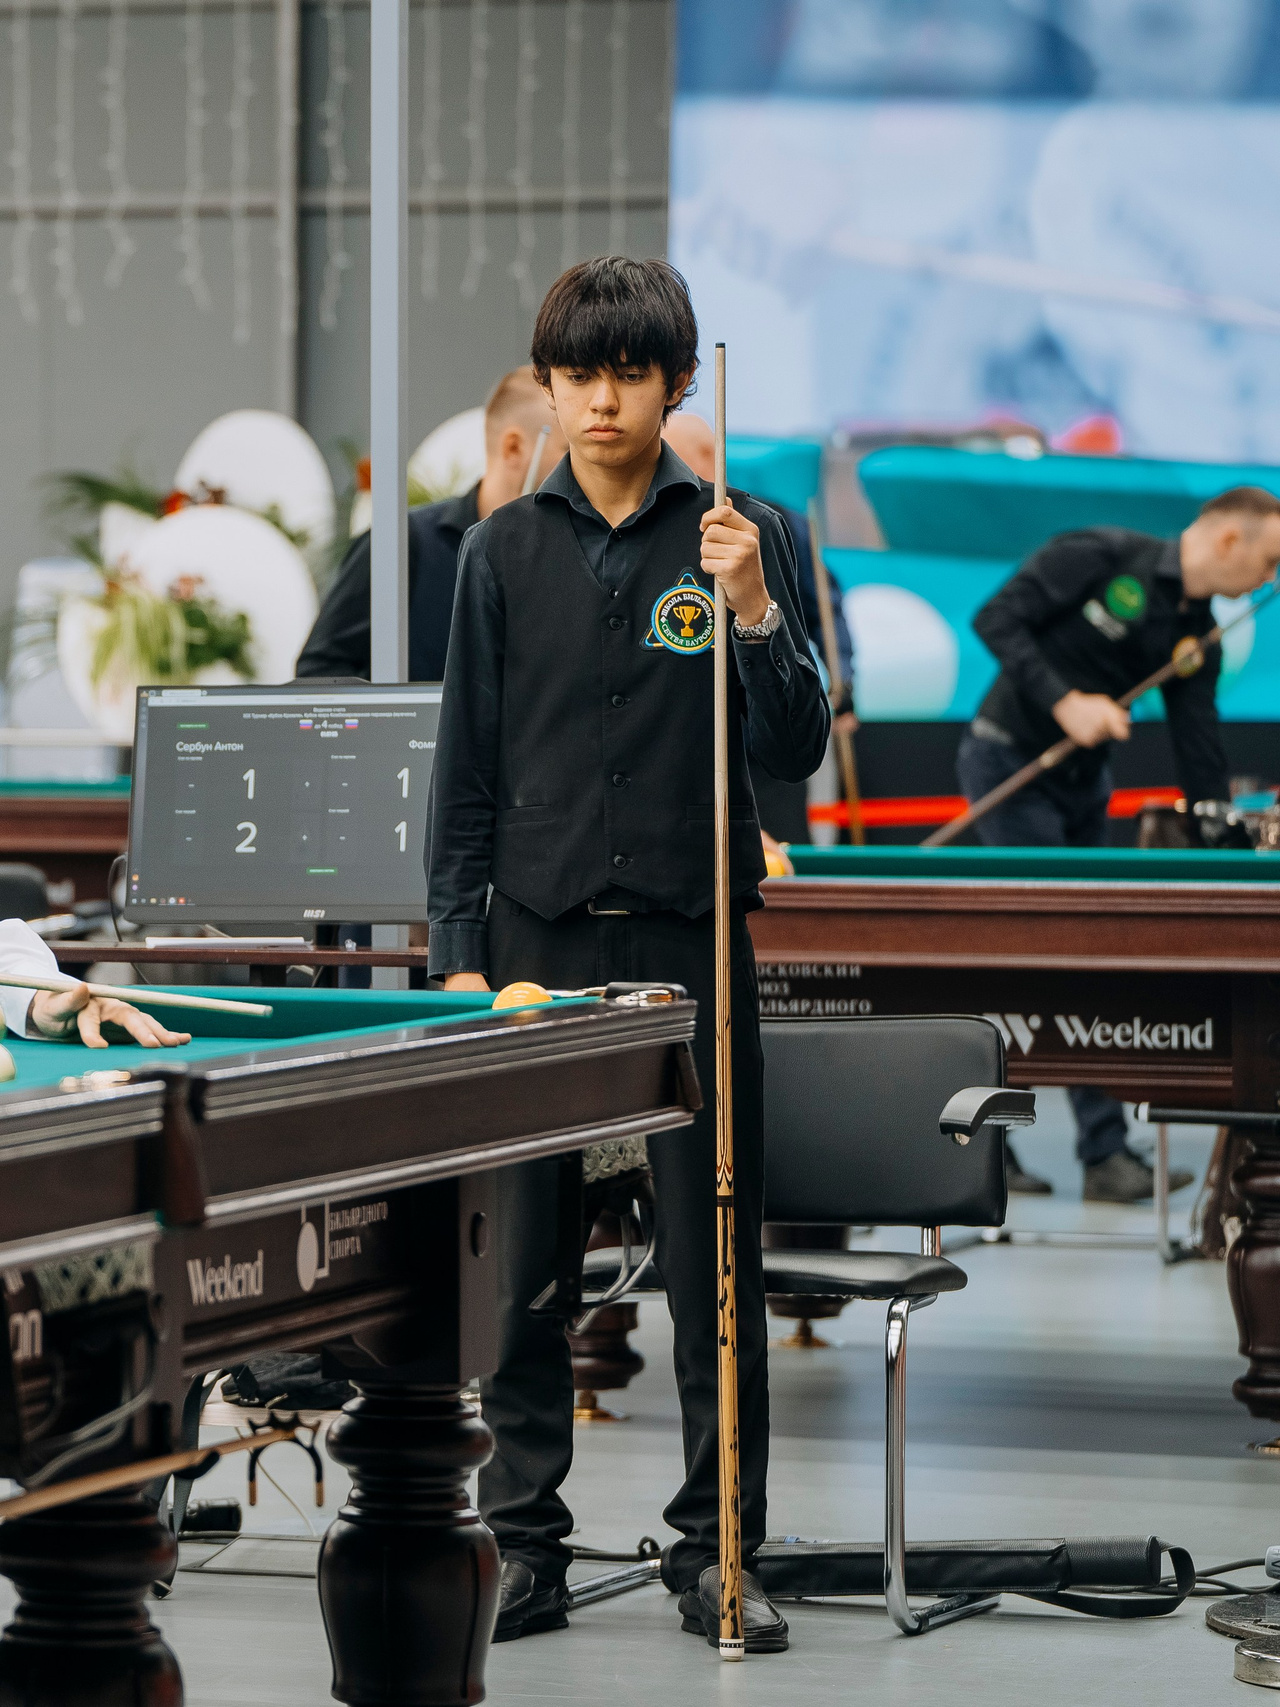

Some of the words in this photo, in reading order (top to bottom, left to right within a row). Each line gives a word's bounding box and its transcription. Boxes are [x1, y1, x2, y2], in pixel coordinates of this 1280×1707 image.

[661, 595, 682, 617] ШКОЛА
[682, 593, 713, 618] БИЛЬЯРДА
[661, 624, 685, 645] СЕРГЕЯ
[685, 625, 713, 647] БАУРОВА
[176, 741, 212, 753] Сербун
[214, 741, 244, 751] Антон
[408, 739, 436, 750] Фоми
[242, 768, 256, 800] 1
[396, 767, 410, 799] 1
[235, 821, 258, 853] 2
[394, 820, 408, 852] 1
[1055, 1013, 1214, 1050] Weekend
[186, 1249, 265, 1306] Weekend
